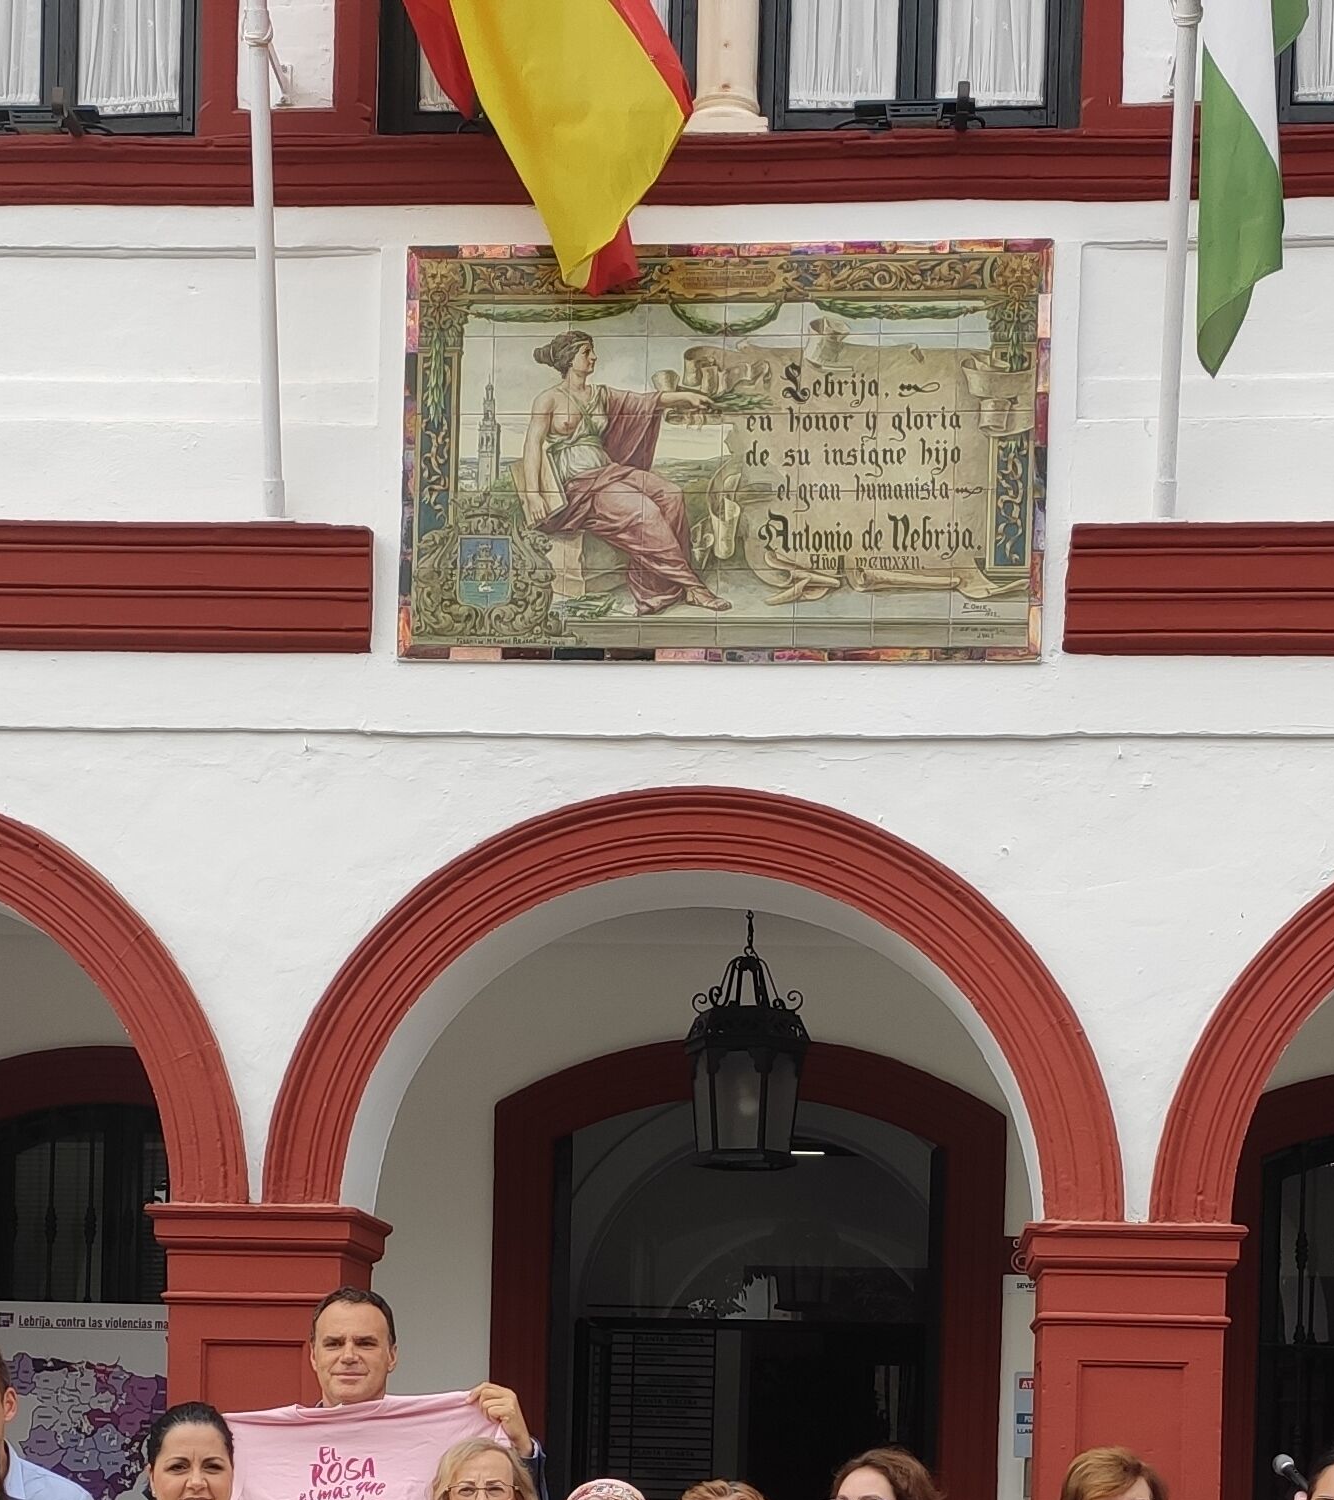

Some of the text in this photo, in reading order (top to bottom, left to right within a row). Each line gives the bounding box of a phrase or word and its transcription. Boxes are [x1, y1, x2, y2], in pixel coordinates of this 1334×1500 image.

[780, 362, 890, 408] Lebrija,
[746, 404, 961, 442] en honor y gloria
[745, 437, 961, 477] de su insigne hijo
[776, 473, 950, 513] el gran humanista
[757, 509, 983, 560] Antonio de Nebrija.
[19, 1314, 53, 1329] Lebrija,
[56, 1317, 86, 1328] contra
[88, 1316, 103, 1328] las
[105, 1316, 153, 1329] violencias
[309, 1457, 375, 1487] ROSA
[317, 1480, 353, 1500] más
[355, 1481, 386, 1496] que
